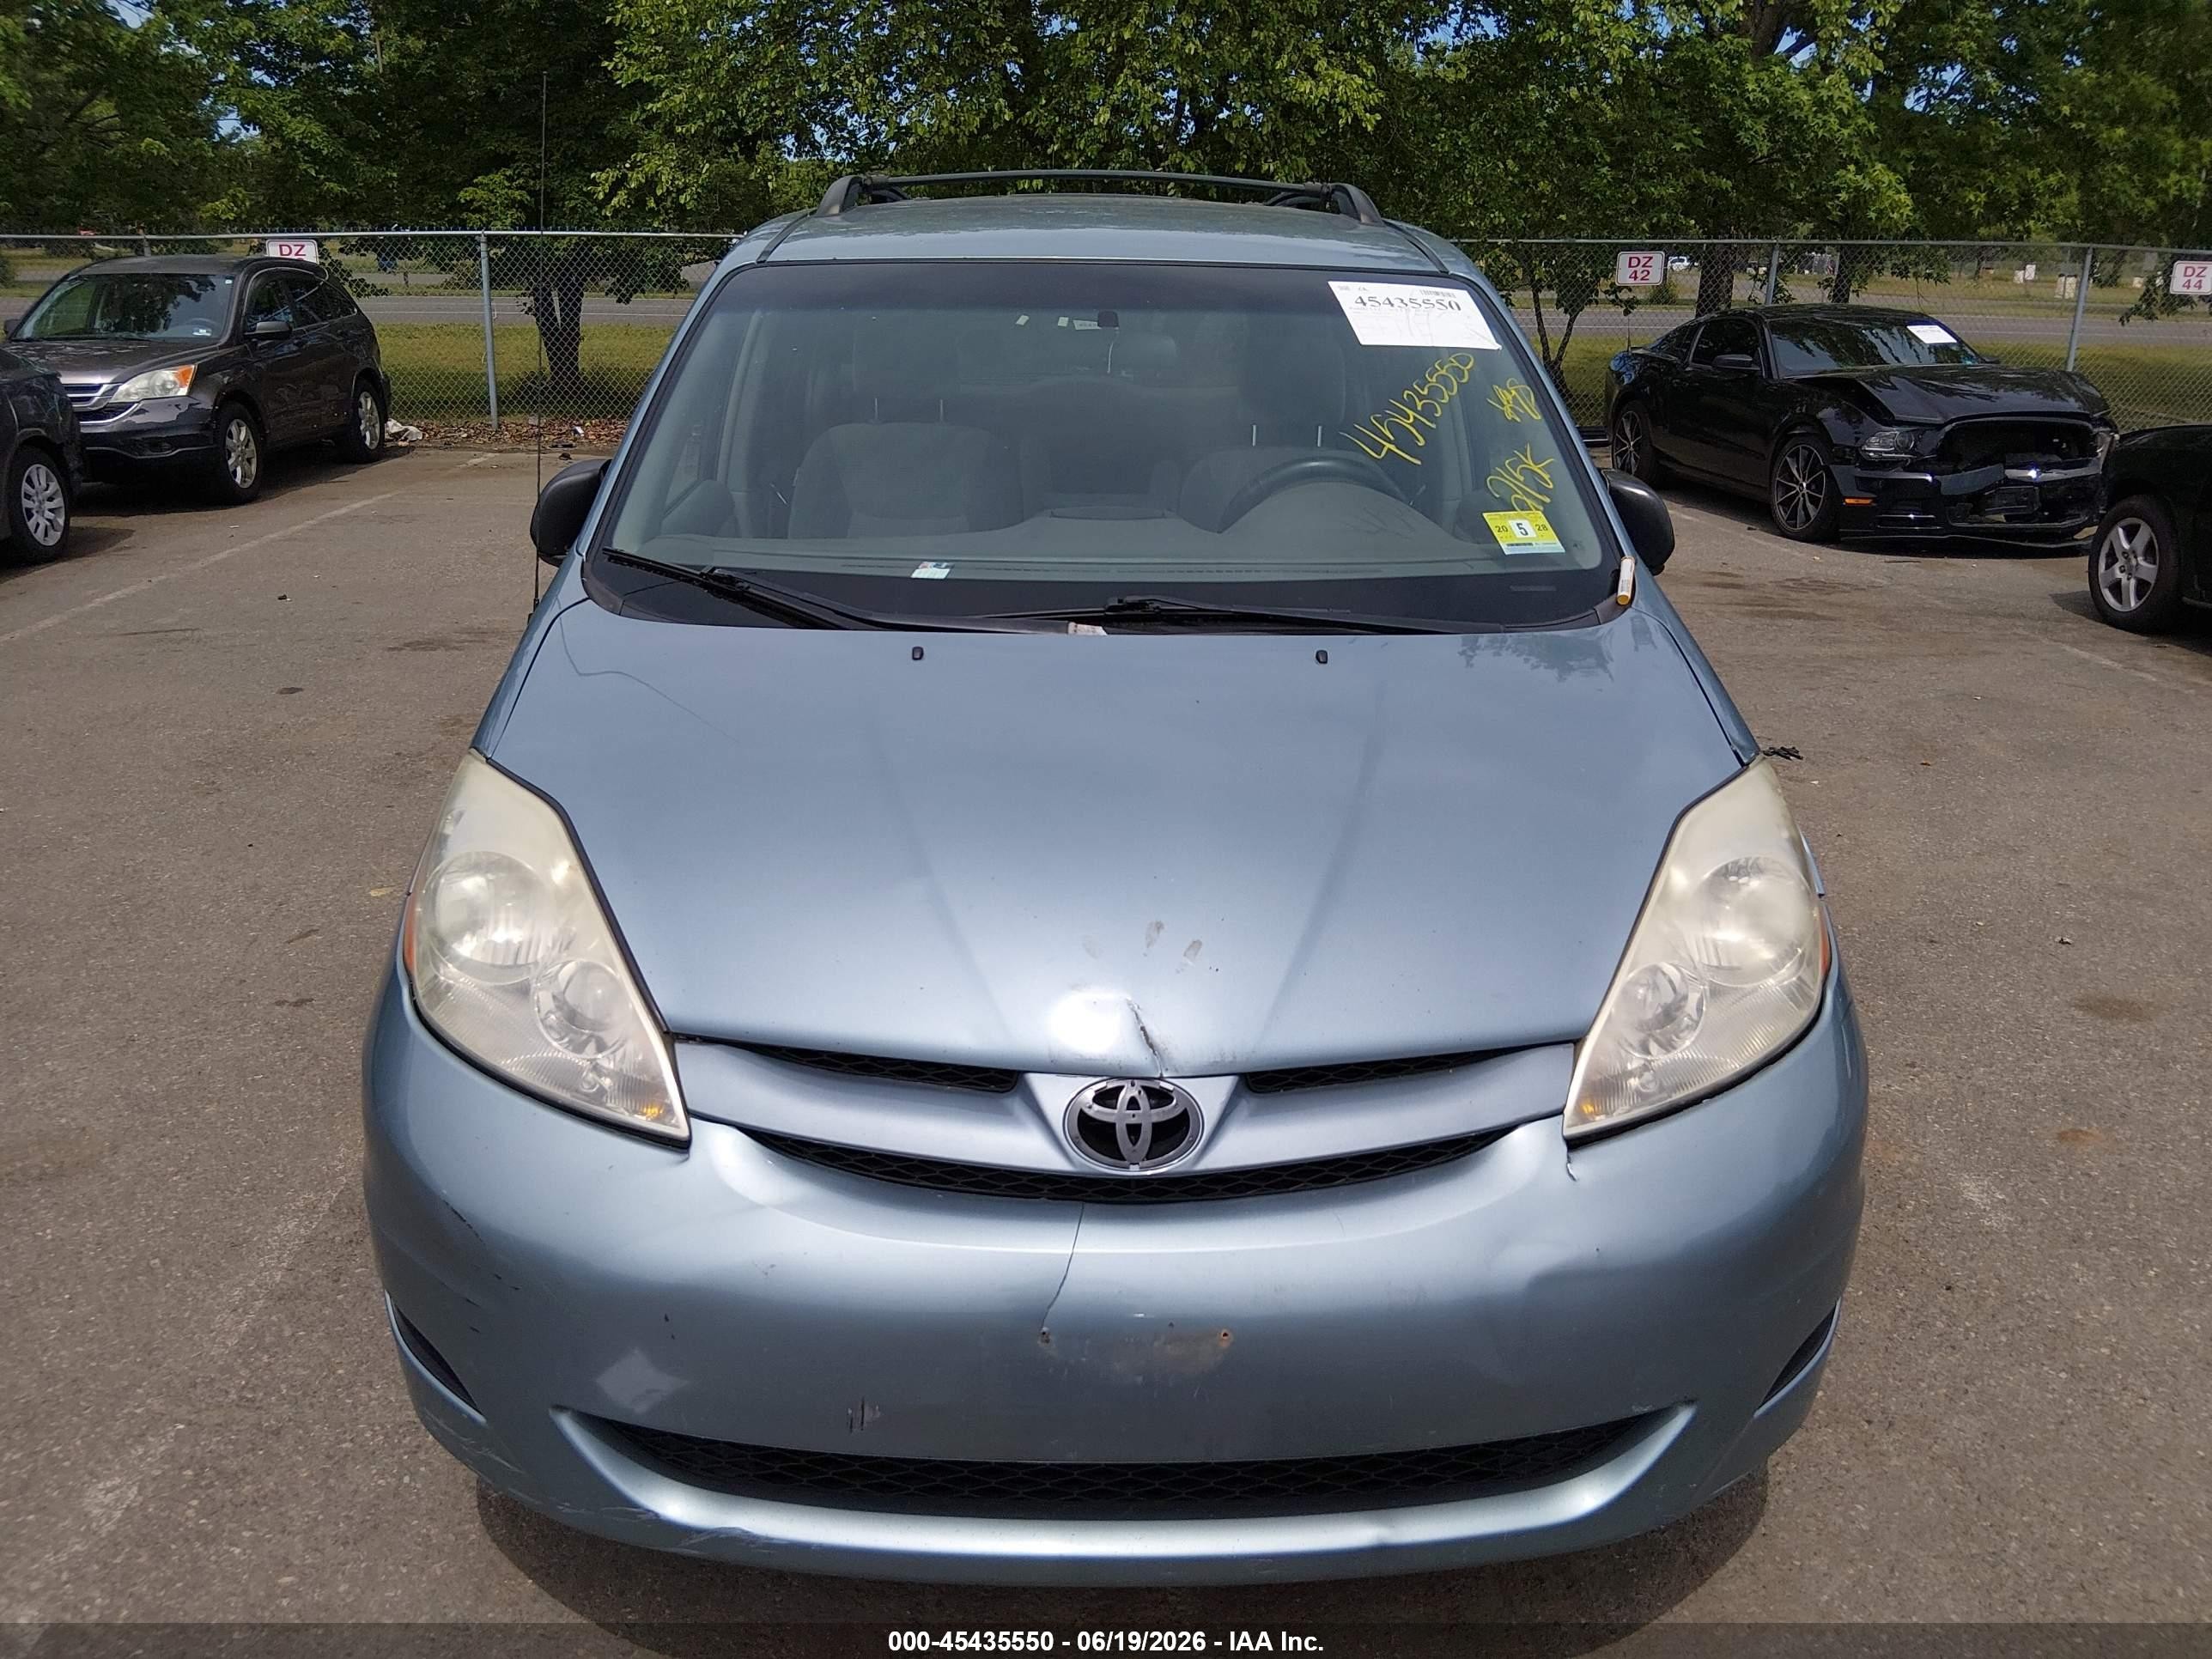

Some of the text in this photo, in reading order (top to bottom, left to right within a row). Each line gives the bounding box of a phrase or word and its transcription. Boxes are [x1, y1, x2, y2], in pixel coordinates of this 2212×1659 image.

[279, 245, 306, 256] DZ
[1628, 257, 1653, 268] DZ
[1629, 270, 1650, 281] 42
[2184, 266, 2208, 277] DZ
[2182, 279, 2203, 290] 44
[1354, 295, 1462, 311] 45435550
[1338, 352, 1474, 465] 45435550
[1495, 525, 1509, 533] 20
[1516, 522, 1528, 537] 5
